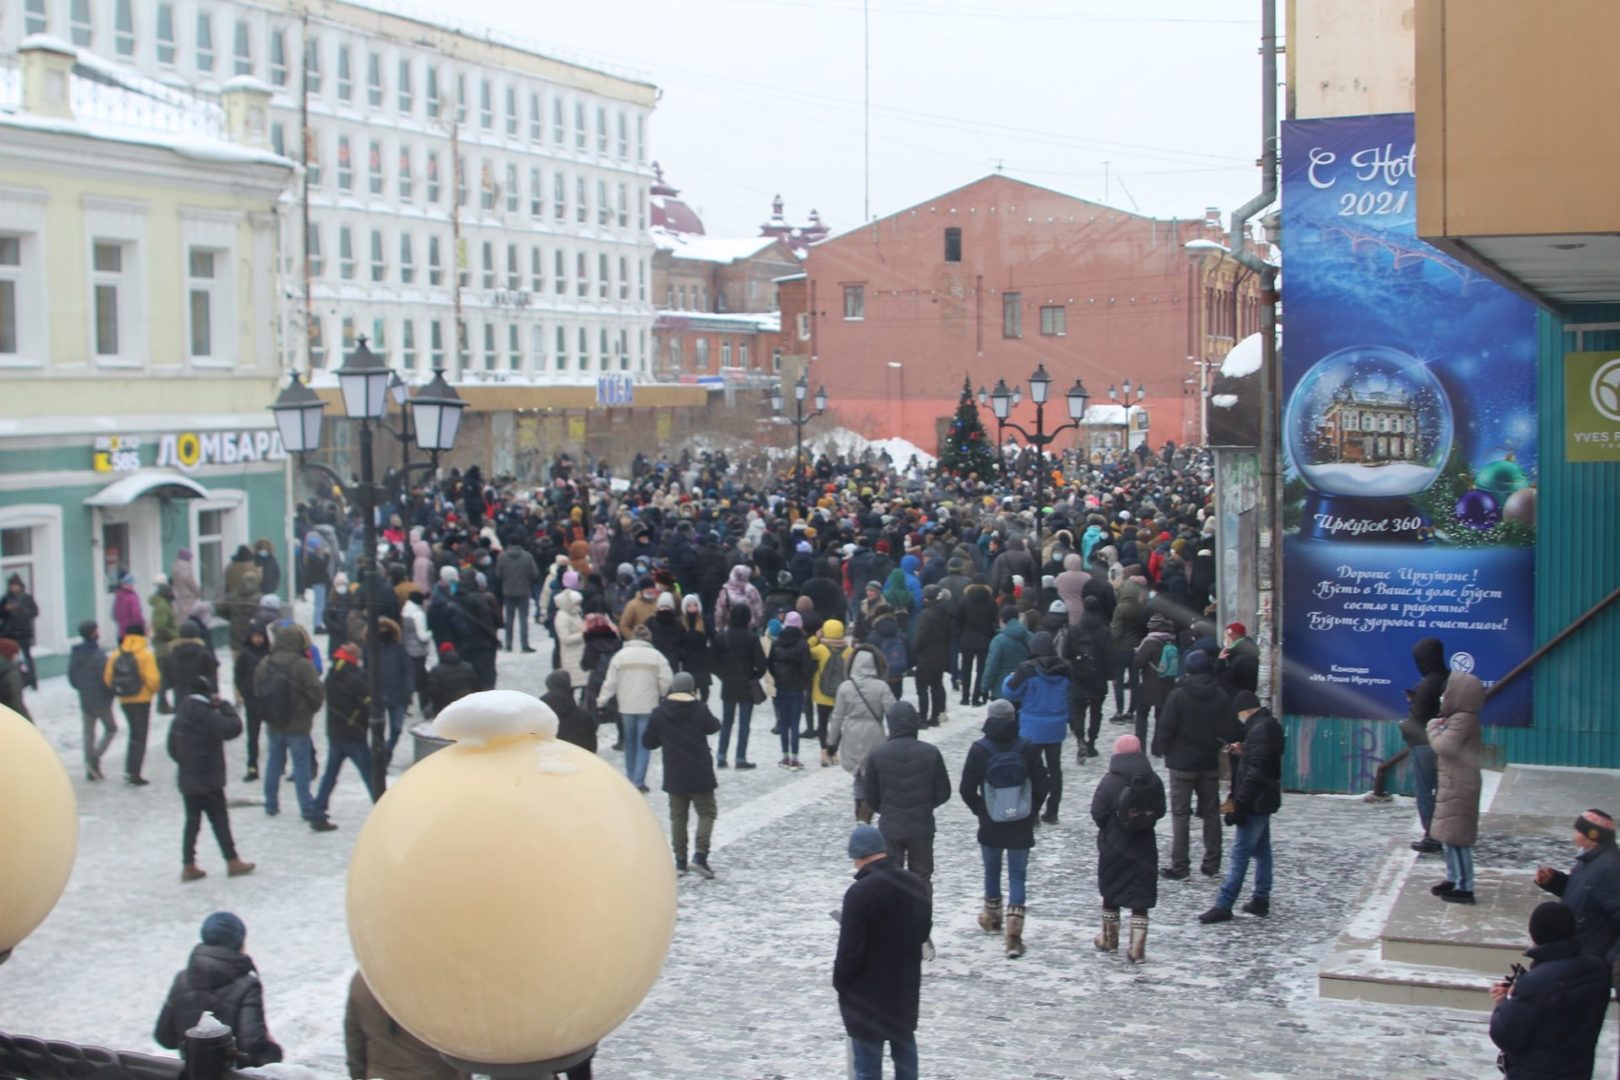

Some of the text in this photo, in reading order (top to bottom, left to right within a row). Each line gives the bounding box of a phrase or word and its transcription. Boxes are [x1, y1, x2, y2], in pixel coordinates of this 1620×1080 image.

[1308, 147, 1336, 189] С
[1337, 190, 1409, 216] 2021
[1573, 431, 1609, 442] YVES
[156, 431, 287, 470] ЛОМБАРД
[1313, 513, 1422, 536] Иркутск 360
[1336, 565, 1391, 584] Дорогие
[1312, 580, 1361, 600] Пусть
[1363, 586, 1371, 594] в
[1373, 581, 1423, 596] Вашем
[1416, 588, 1457, 603] доме
[1390, 603, 1399, 611] и
[1306, 611, 1509, 633] Будьте здоровы и счастливы!
